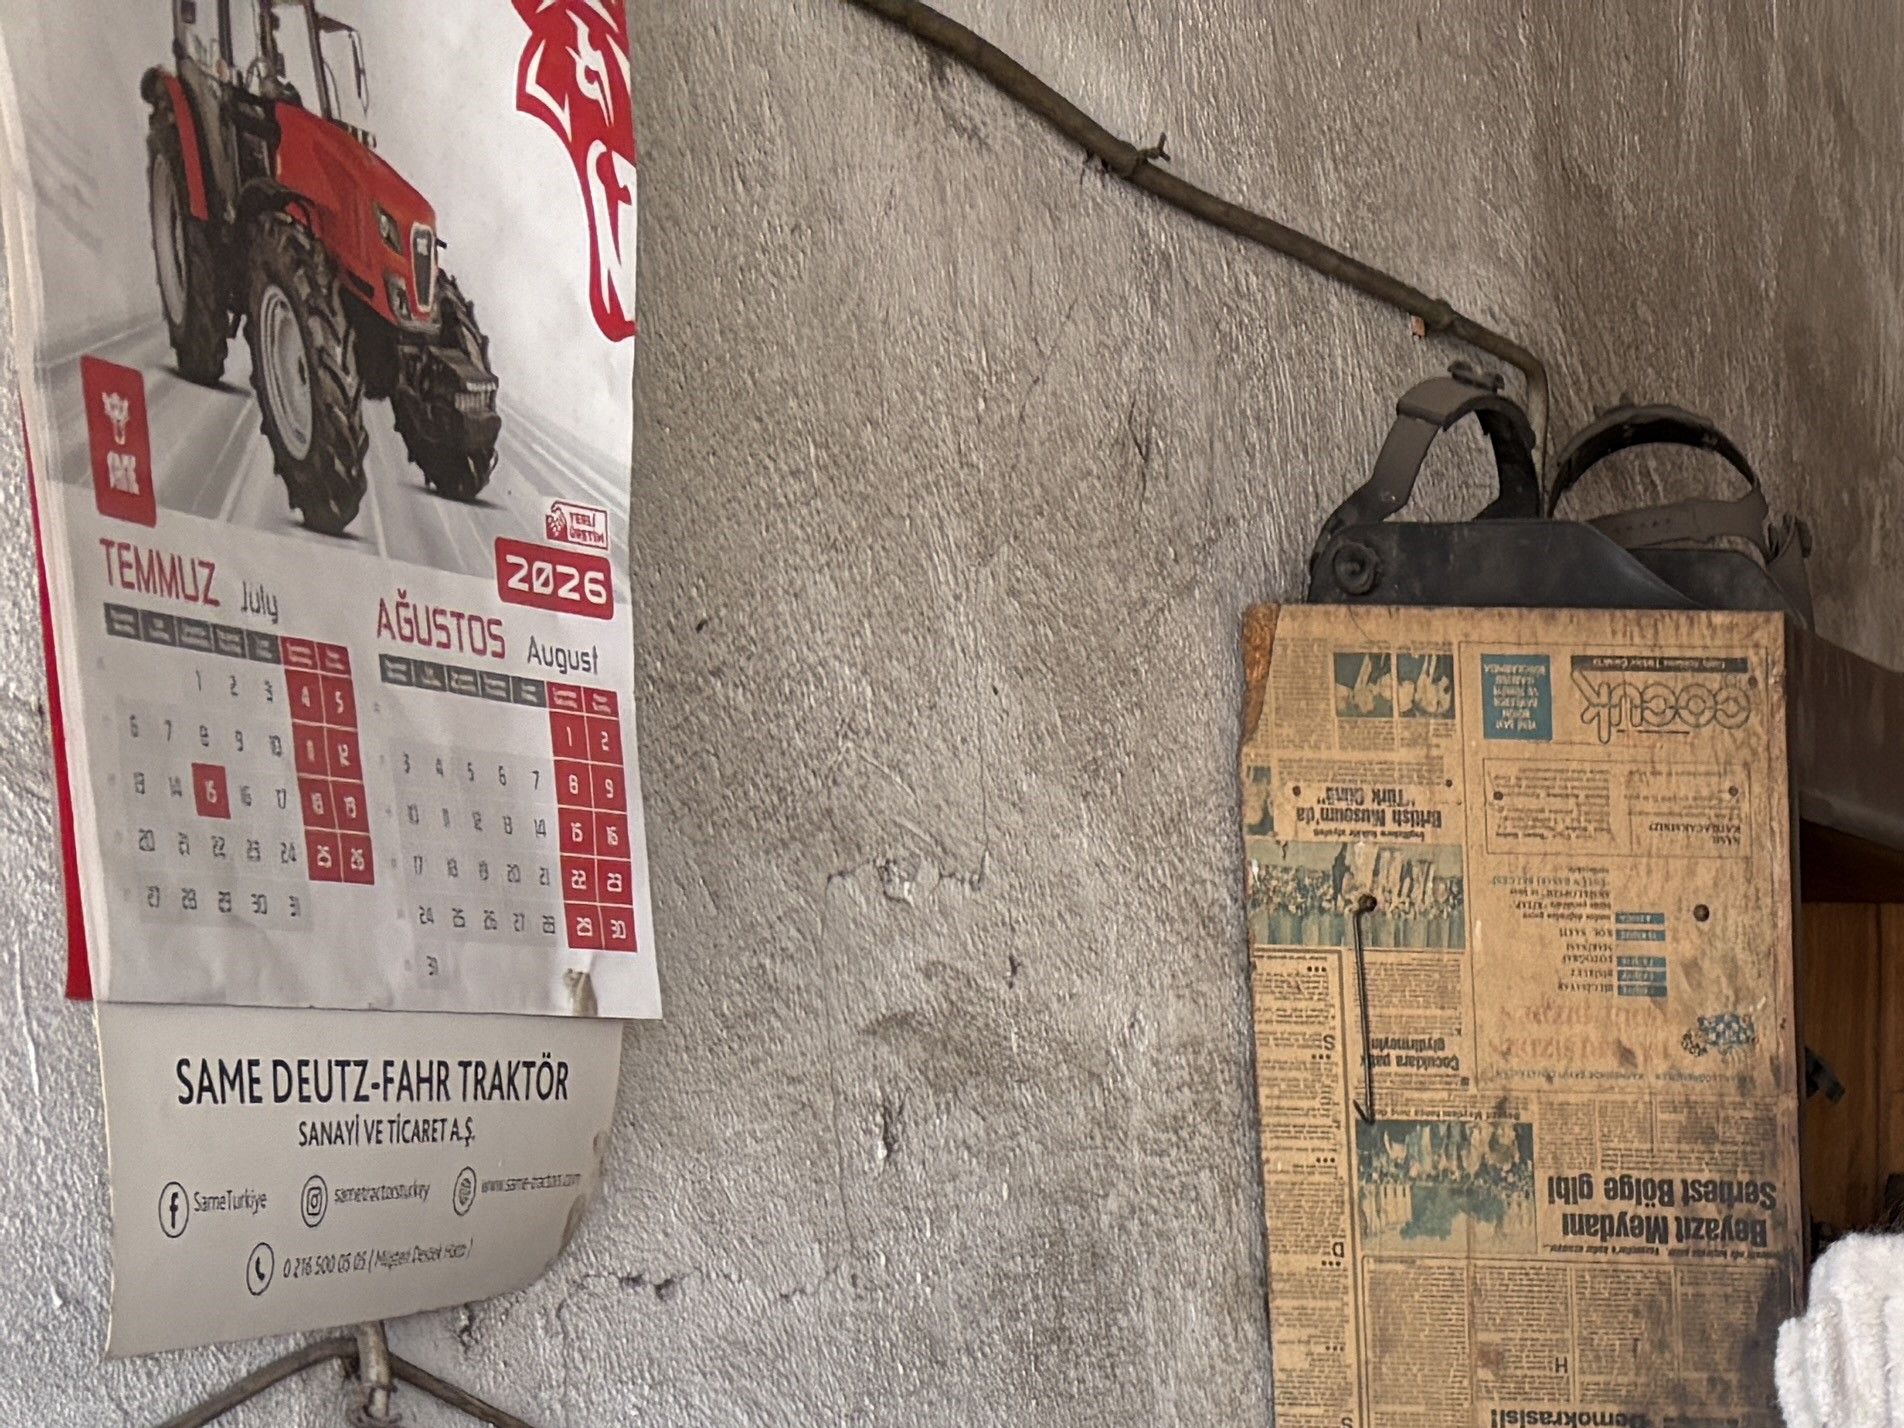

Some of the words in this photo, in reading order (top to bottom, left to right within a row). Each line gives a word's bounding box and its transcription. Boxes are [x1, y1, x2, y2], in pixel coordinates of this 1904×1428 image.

[99, 538, 220, 607] TEMMUZ
[240, 581, 278, 624] July
[505, 554, 607, 605] 2026
[376, 588, 506, 659] AĞUSTOS
[527, 635, 599, 676] August
[1297, 808, 1385, 827] Museum'da
[1393, 810, 1442, 828] British
[176, 1057, 263, 1106] SAME
[272, 1057, 451, 1104] DEUTZ-FAHR
[457, 1052, 569, 1102] TRAKTÖR
[1396, 1055, 1459, 1071] Çocuklara
[298, 1113, 360, 1148] SANAYİ
[364, 1118, 383, 1145] VE
[387, 1112, 447, 1145] TİCARET
[450, 1116, 476, 1148] A.Ş.
[1547, 1173, 1594, 1205] gibi
[1603, 1176, 1674, 1209] Bölge
[1680, 1178, 1777, 1211] Serbest
[1562, 1211, 1669, 1245] Meydanı
[1675, 1214, 1768, 1248] Beyazıt
